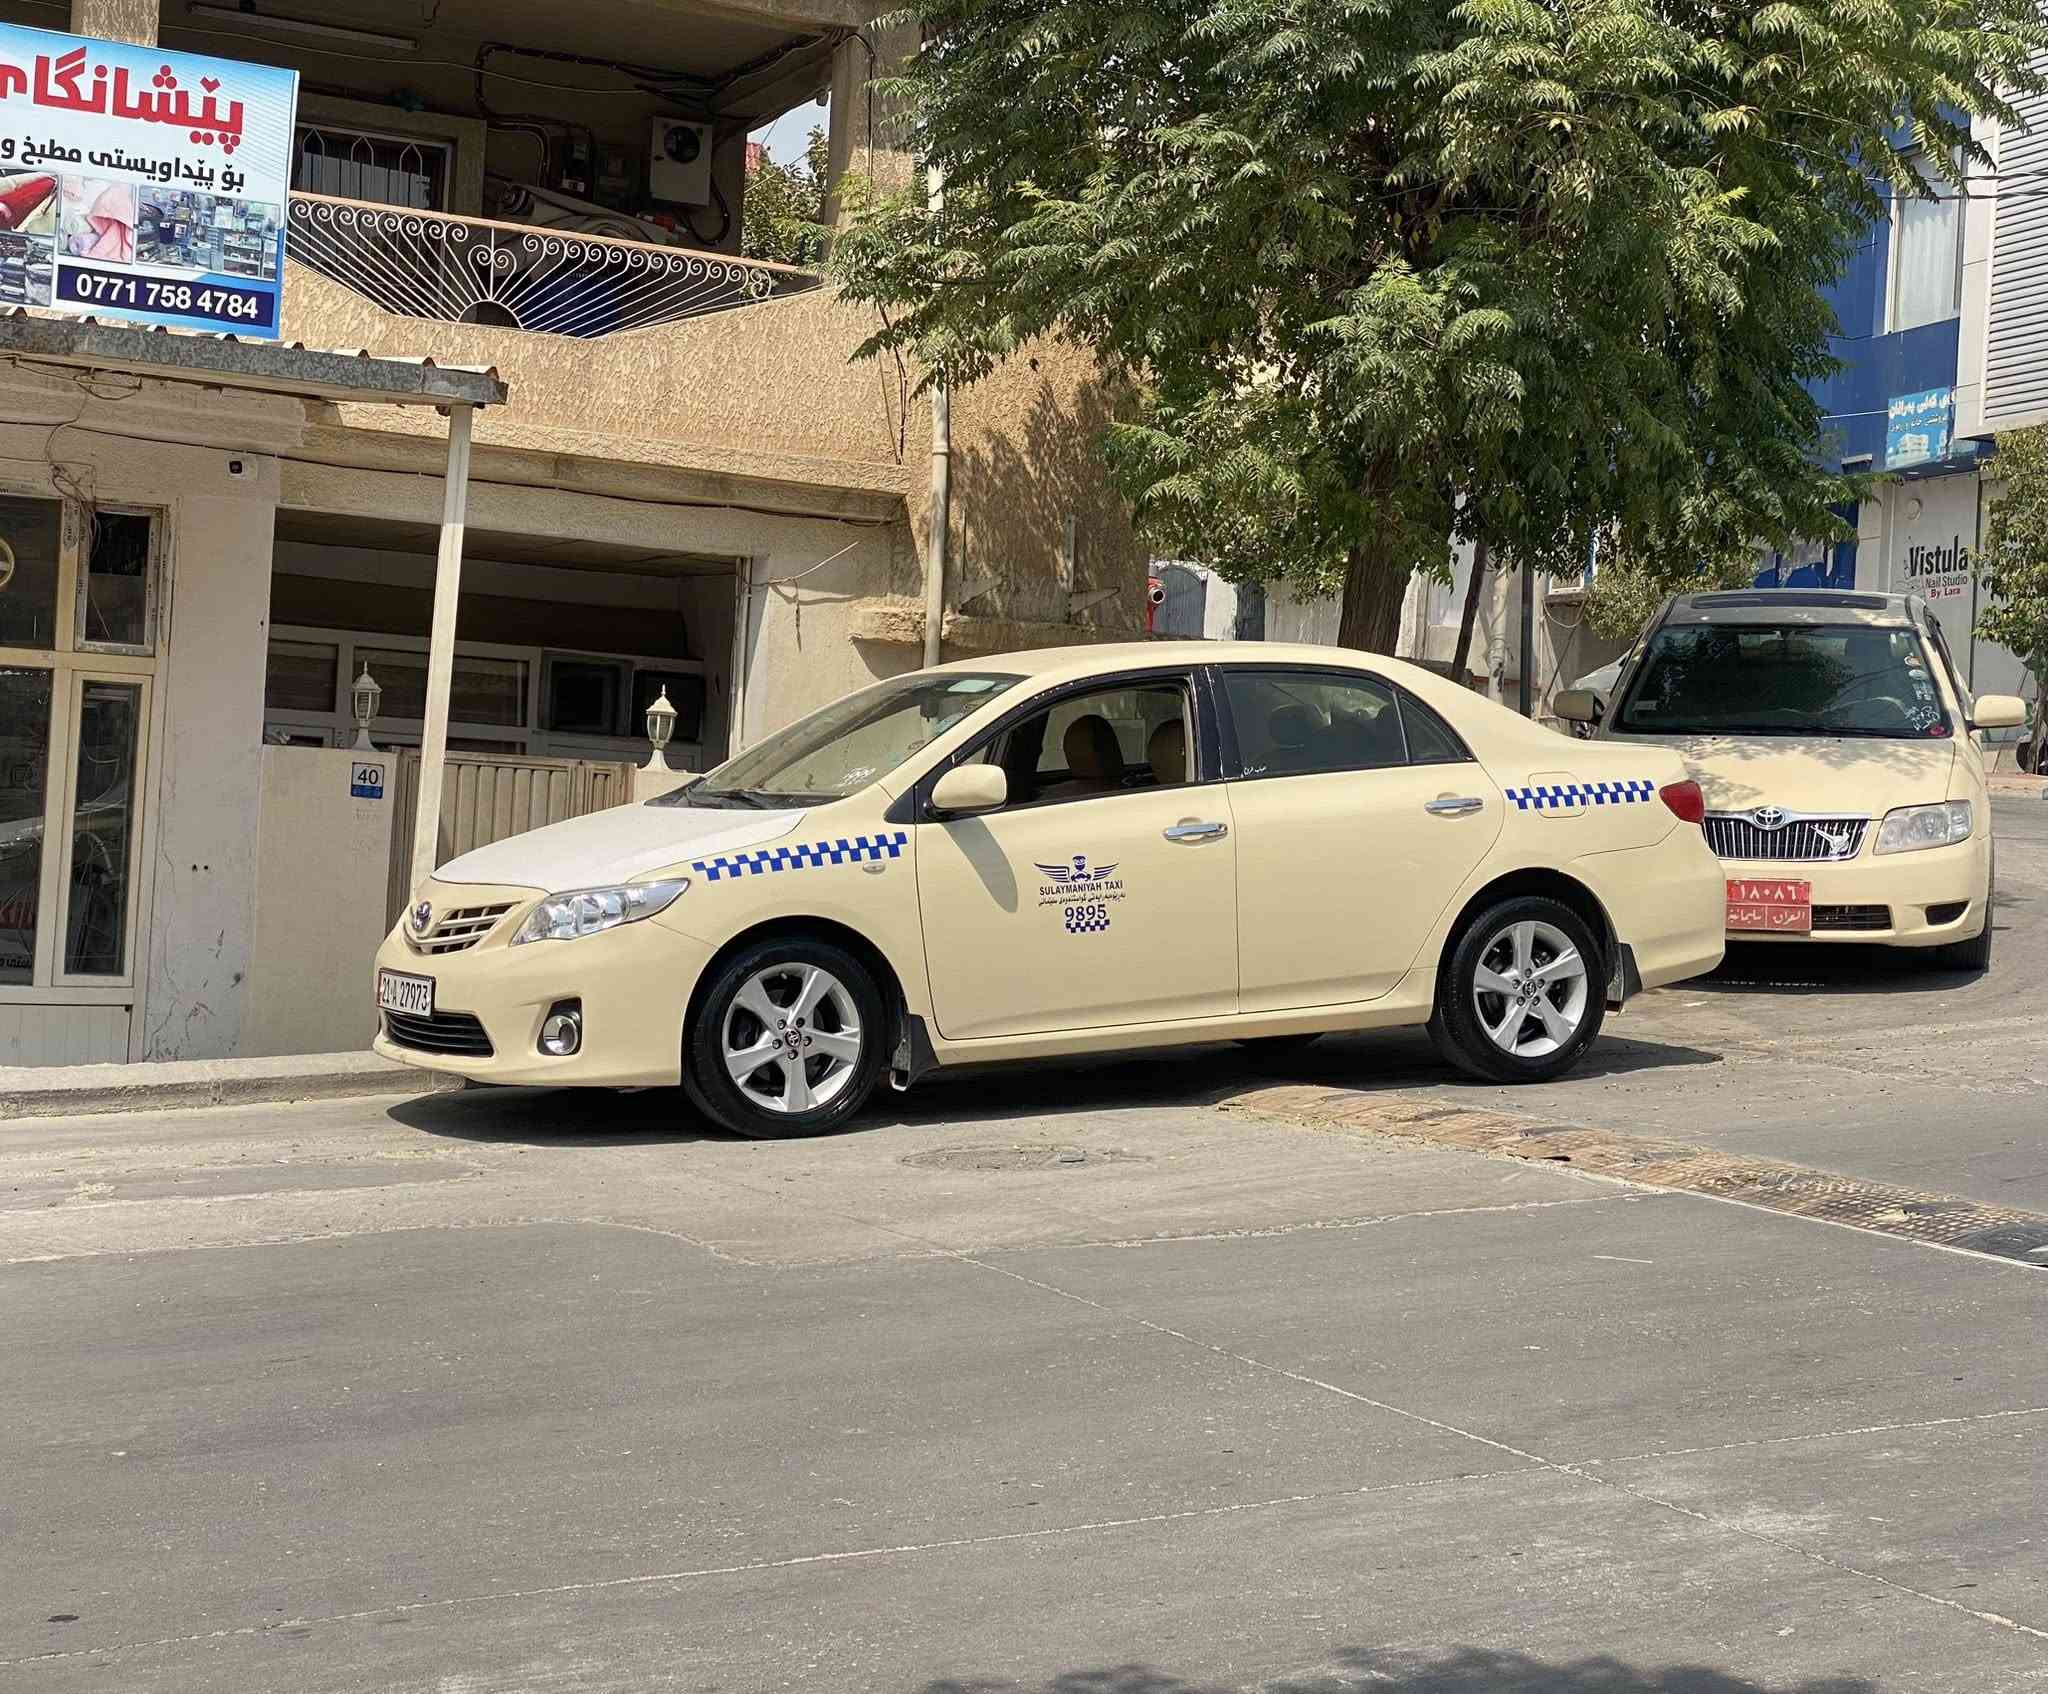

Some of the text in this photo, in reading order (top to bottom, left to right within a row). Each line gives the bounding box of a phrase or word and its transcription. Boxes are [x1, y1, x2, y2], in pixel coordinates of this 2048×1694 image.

[20, 136, 82, 165] مطبخ
[221, 164, 245, 193] بۆ
[76, 273, 258, 319] 0771 758 4784
[1909, 535, 1969, 577] Vistula
[1942, 575, 1968, 588] Studio
[1930, 587, 1960, 599] By Lara
[357, 768, 379, 785] 40
[1039, 879, 1123, 896] SULAYMANIYAH TAXI
[1740, 884, 1797, 901] ١٨٠٨٦
[1064, 903, 1107, 923] 9895
[400, 980, 428, 1011] 27973
